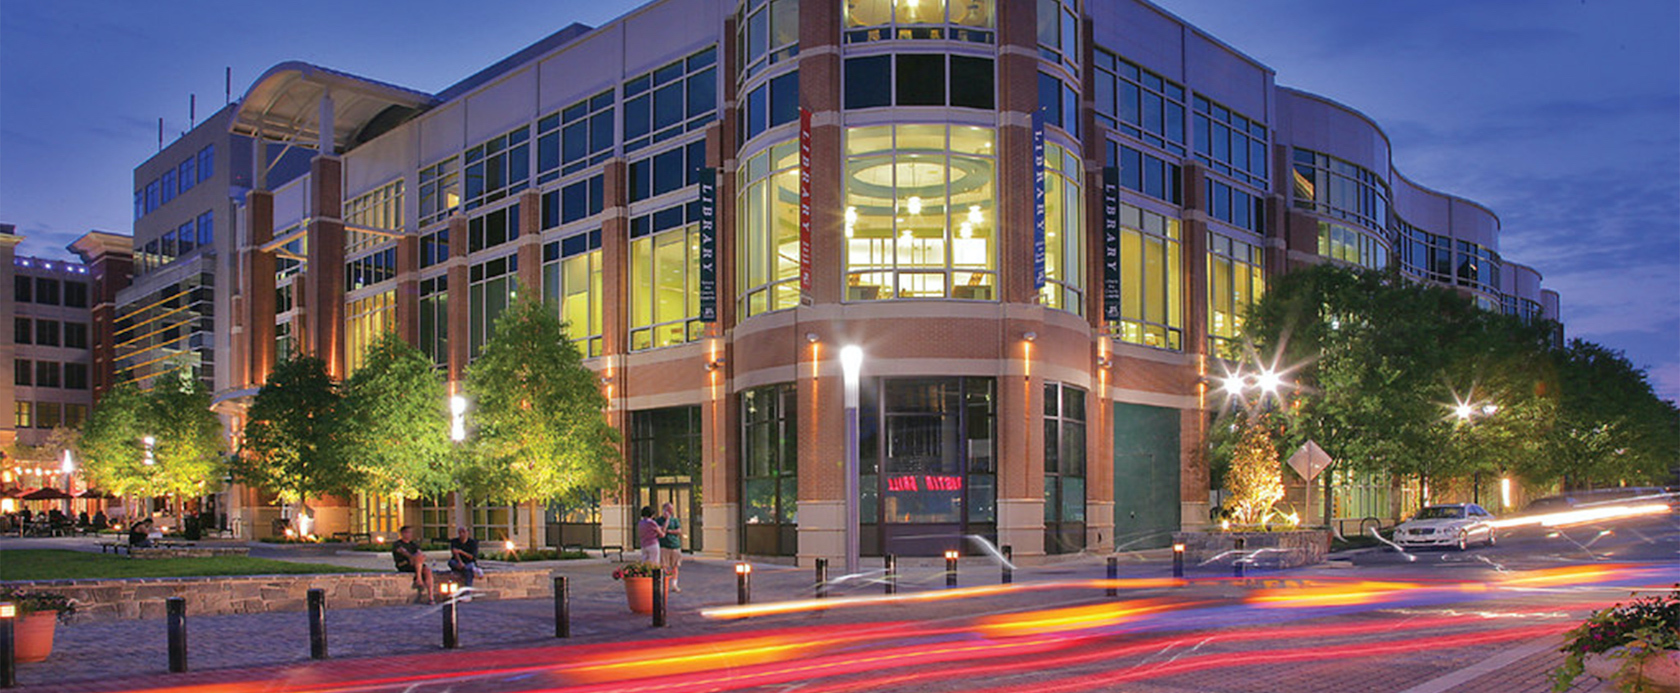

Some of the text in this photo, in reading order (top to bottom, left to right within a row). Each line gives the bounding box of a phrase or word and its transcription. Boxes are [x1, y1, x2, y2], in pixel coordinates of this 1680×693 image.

[702, 184, 713, 272] LIBRARY
[803, 131, 813, 232] LIBRARY
[1035, 131, 1045, 232] LIBRARY
[1106, 184, 1117, 272] LIBRARY
